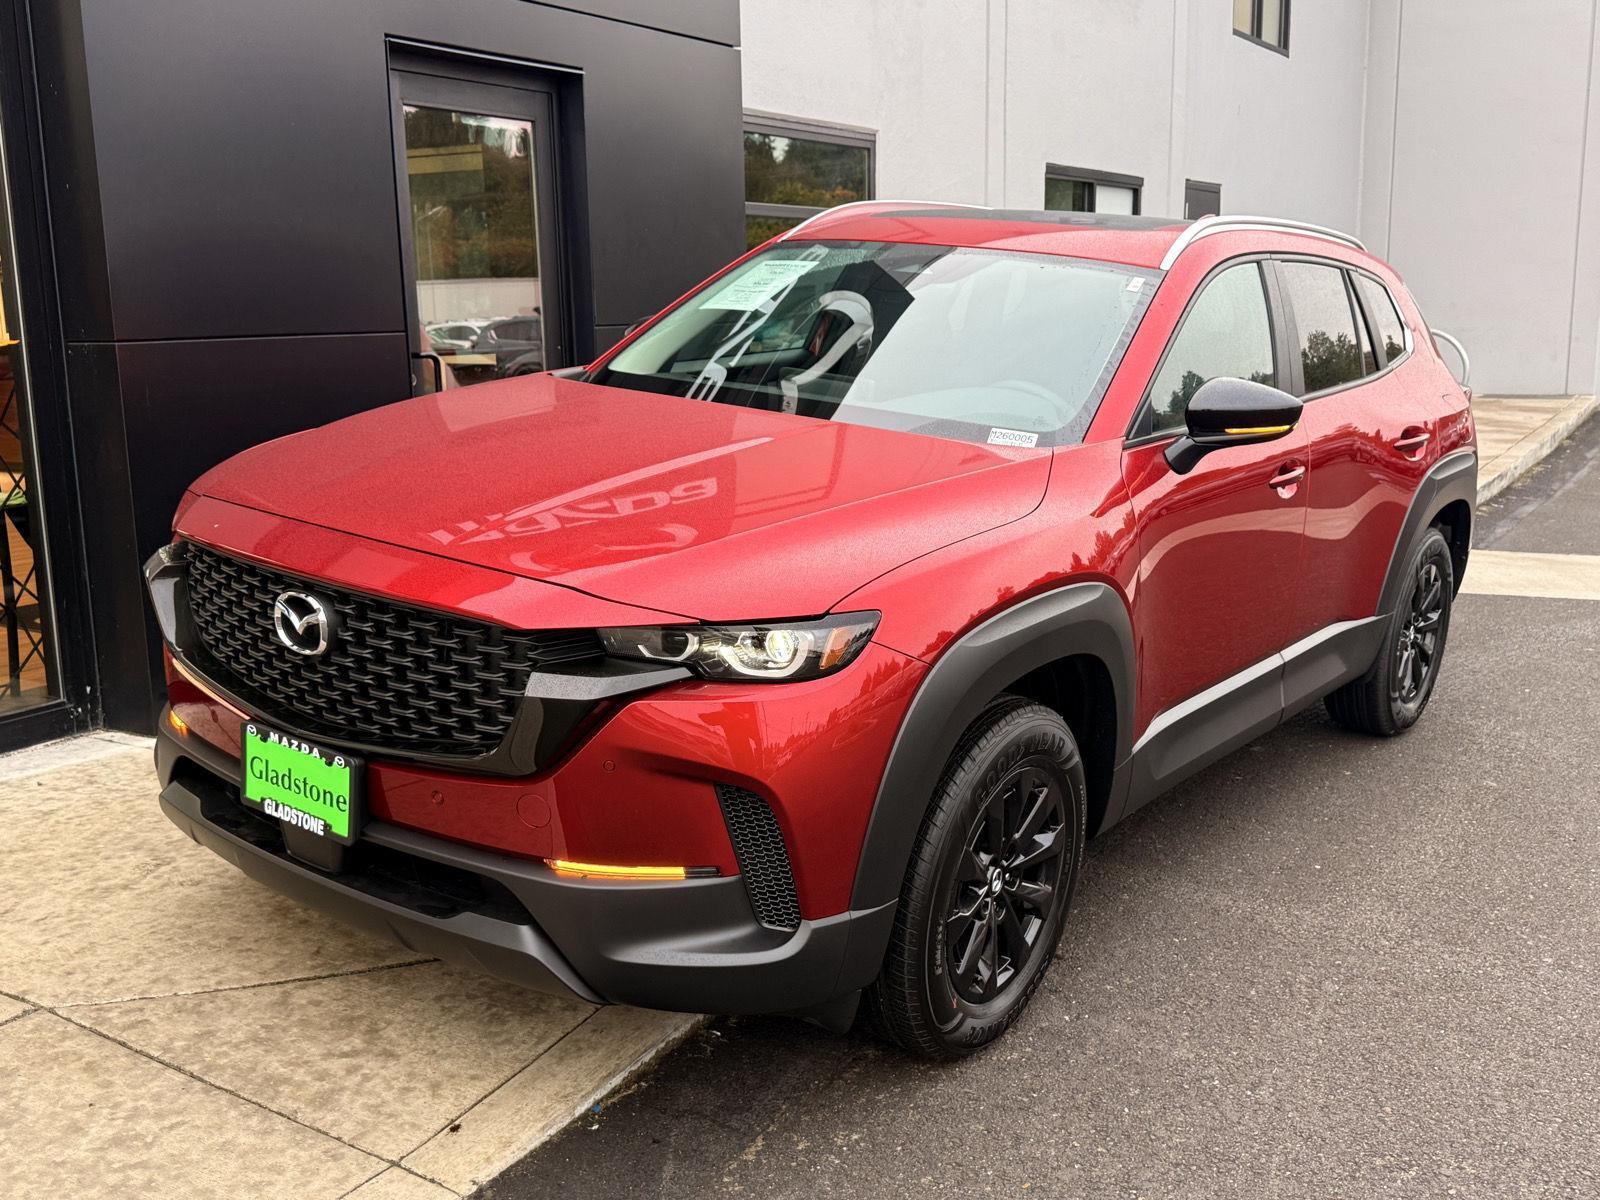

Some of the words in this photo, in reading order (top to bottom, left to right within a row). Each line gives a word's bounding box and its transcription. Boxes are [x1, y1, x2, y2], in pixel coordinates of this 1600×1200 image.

[990, 430, 1033, 444] M260005
[269, 731, 321, 759] MAZDA
[250, 756, 348, 813] Gladstone
[264, 798, 325, 837] GLADSTONE
